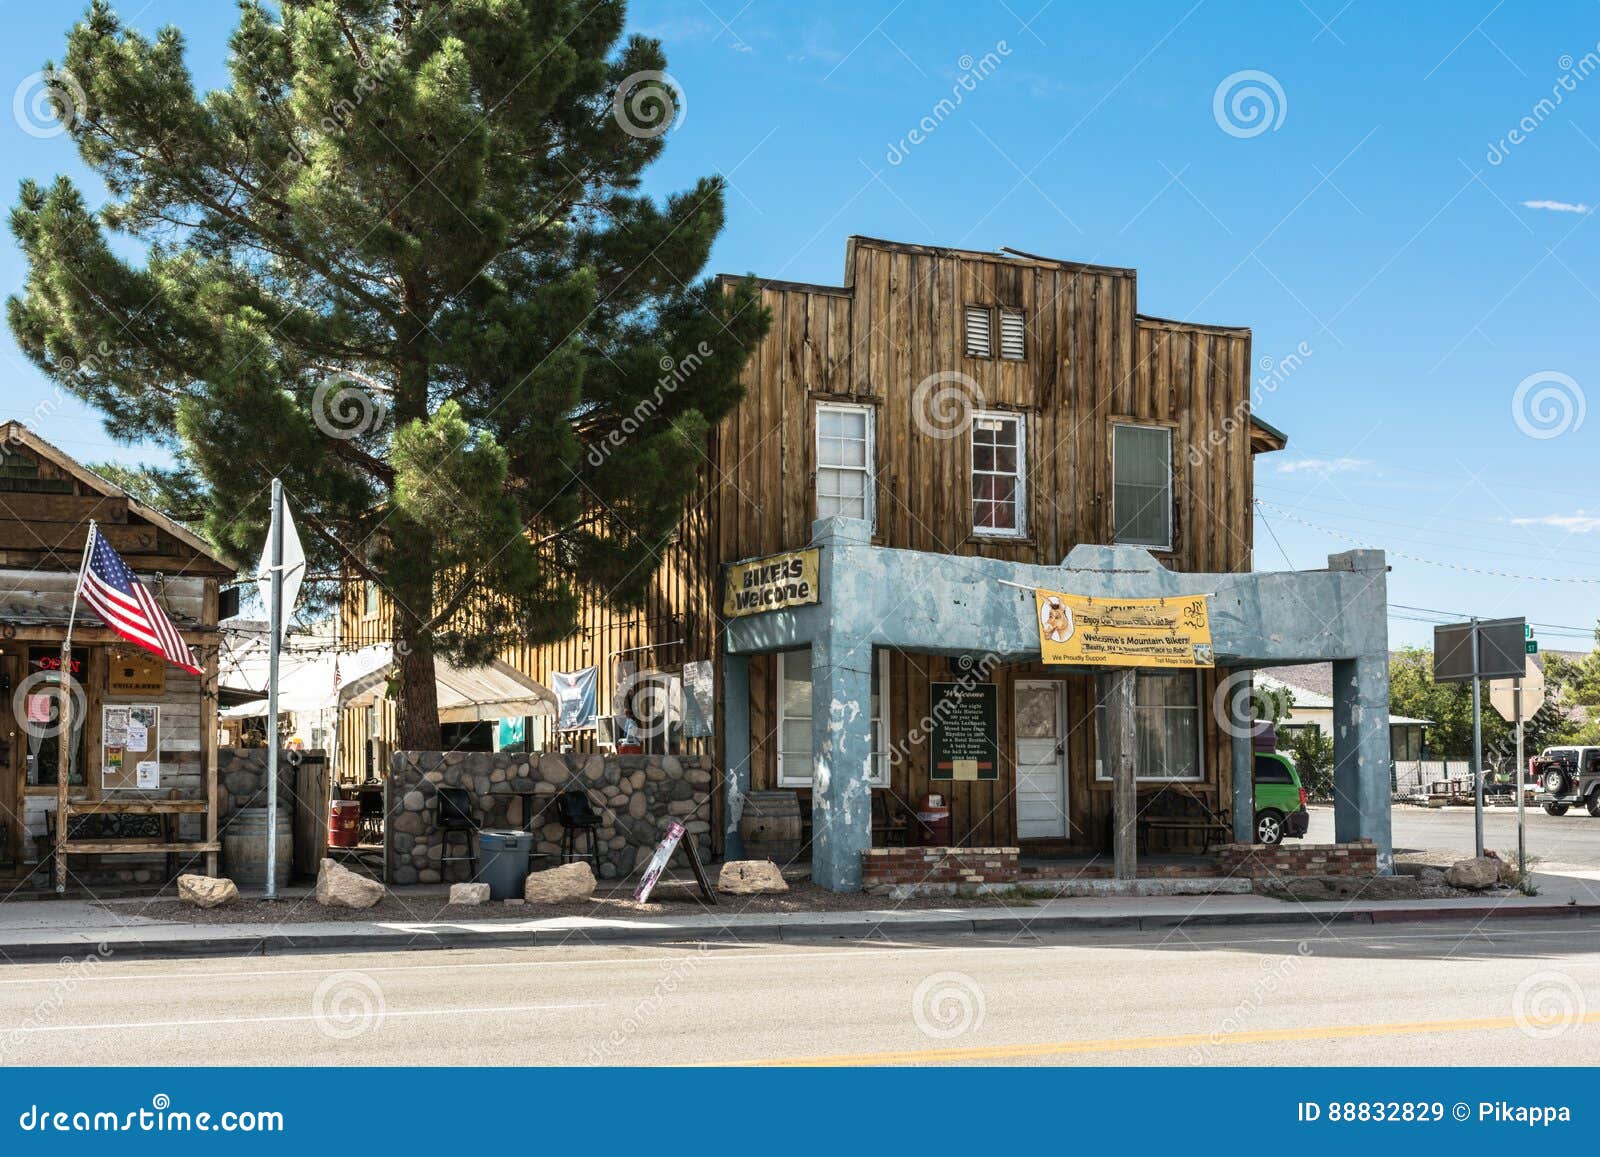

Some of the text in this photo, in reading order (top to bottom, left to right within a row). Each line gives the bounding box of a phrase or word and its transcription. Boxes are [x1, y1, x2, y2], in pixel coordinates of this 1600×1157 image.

[743, 559, 803, 588] BIKERS
[736, 582, 809, 610] Welcome
[1084, 634, 1125, 645] Welcome's
[1127, 636, 1164, 645] Mountain
[39, 657, 80, 672] OPN
